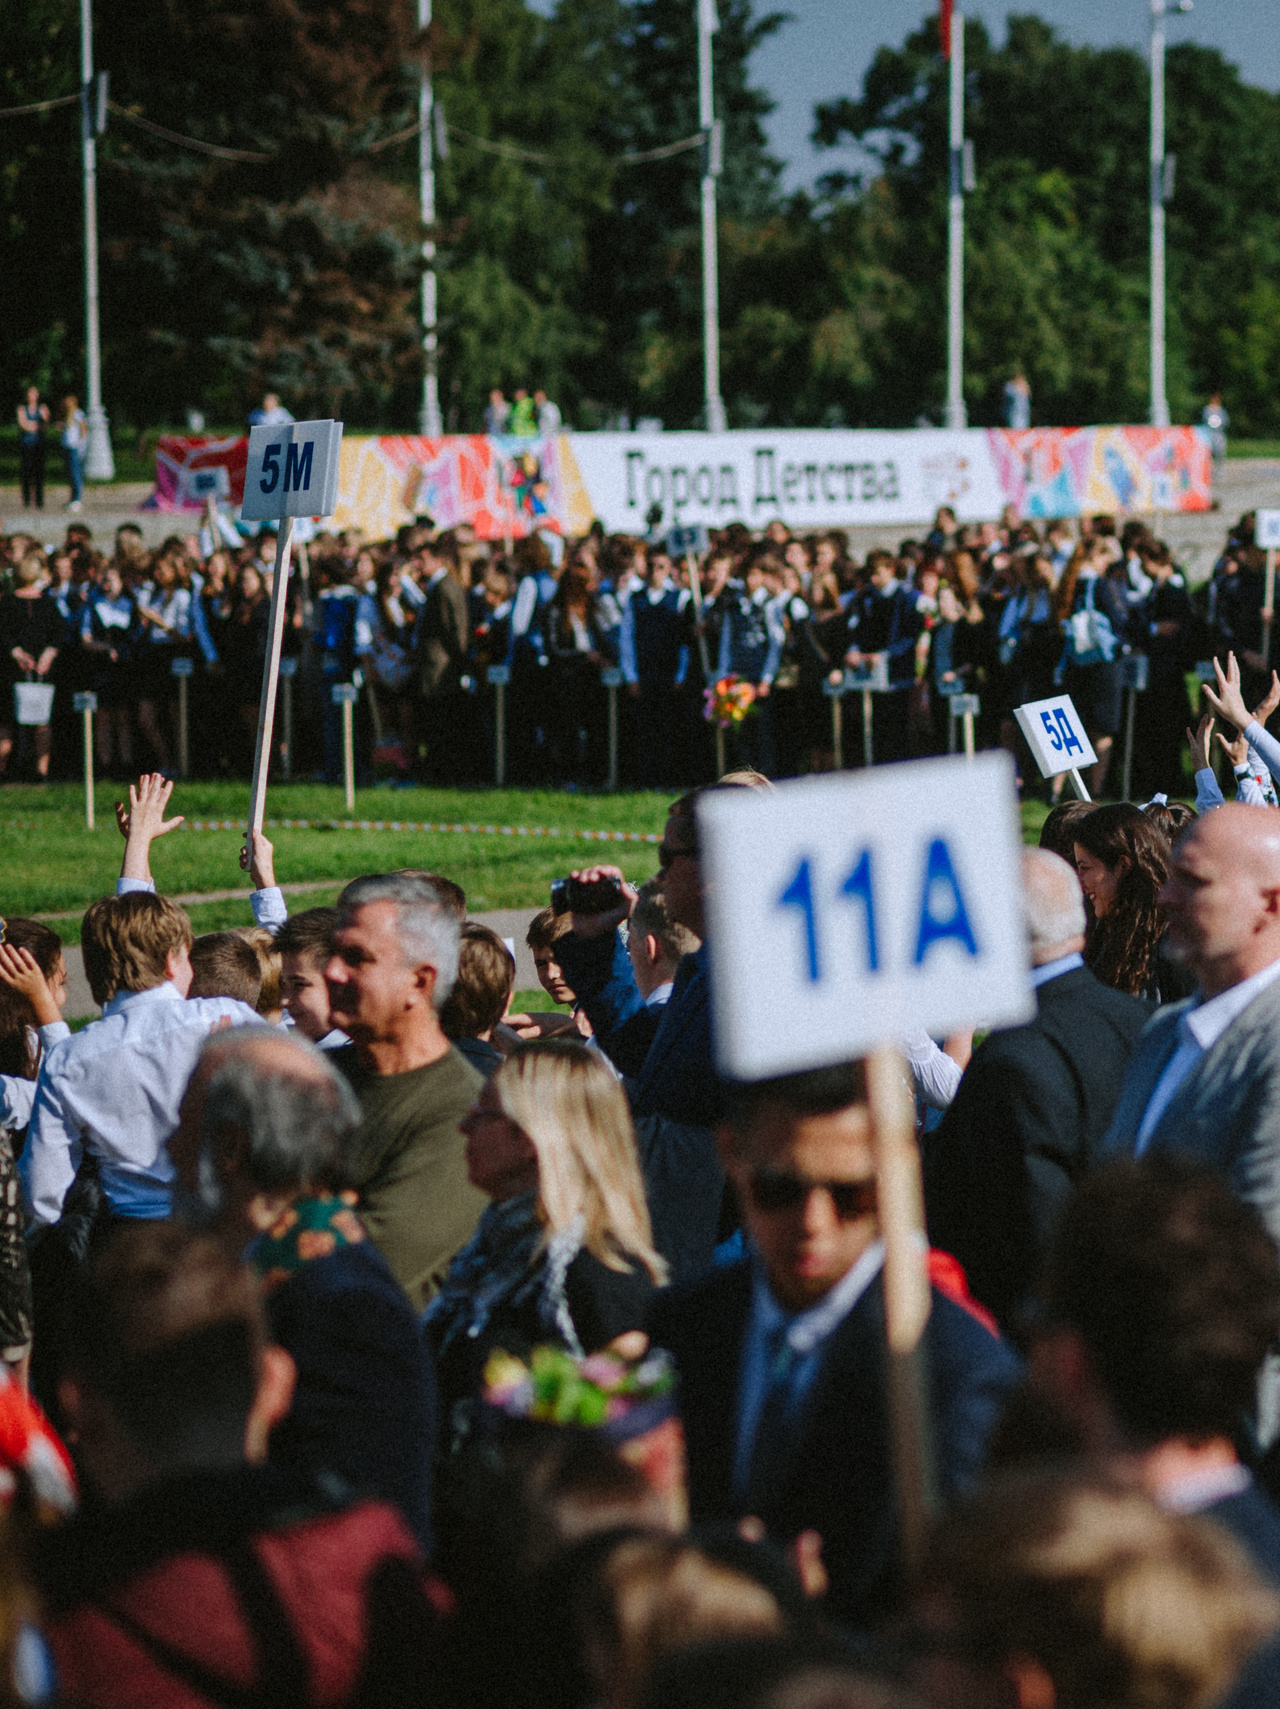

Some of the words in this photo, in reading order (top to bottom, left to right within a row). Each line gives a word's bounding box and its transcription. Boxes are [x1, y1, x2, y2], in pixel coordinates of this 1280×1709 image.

[258, 441, 315, 495] 5М
[625, 449, 739, 523] Город
[752, 448, 899, 513] Детства
[1039, 707, 1084, 757] 5Д
[773, 837, 981, 983] 11А
